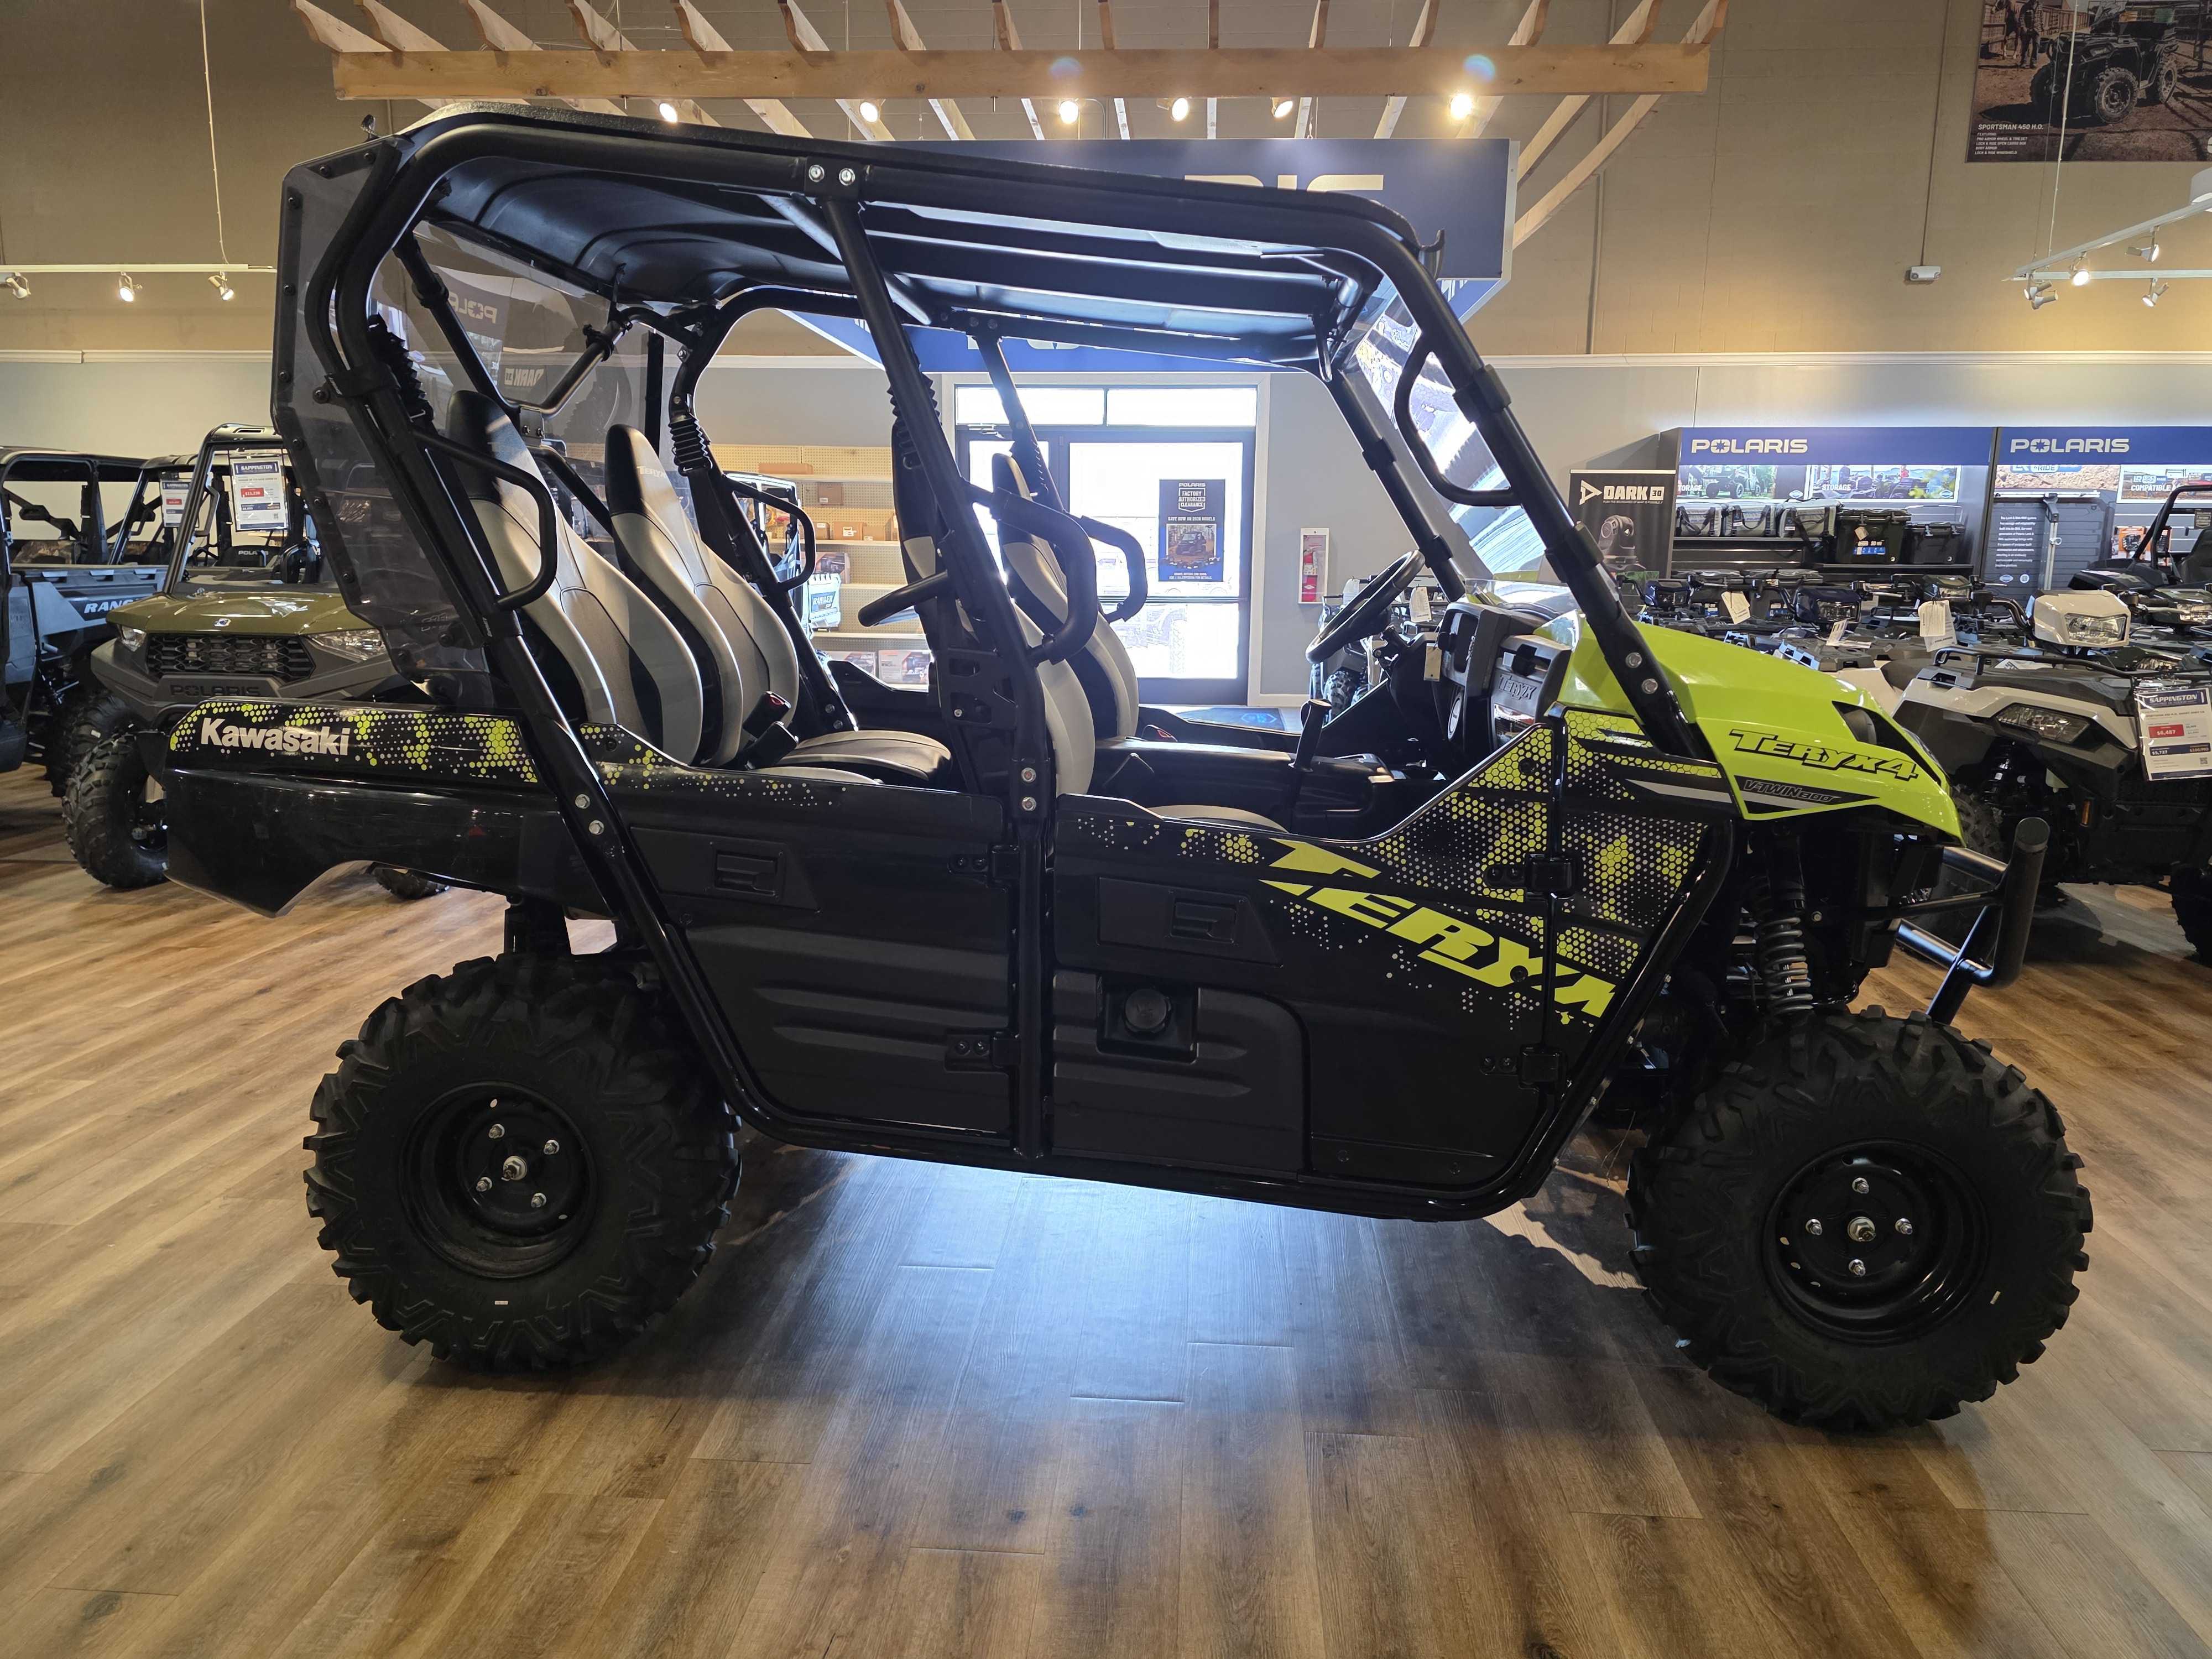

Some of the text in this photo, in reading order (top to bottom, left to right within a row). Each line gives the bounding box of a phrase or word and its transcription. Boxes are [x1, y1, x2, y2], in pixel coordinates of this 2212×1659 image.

[1691, 439, 1808, 453] POLARIS
[2010, 439, 2130, 453] POLARIS
[1604, 486, 1648, 500] DARK
[1822, 483, 1852, 492] STORAGE
[813, 596, 833, 605] RANGER
[170, 684, 260, 696] POLARIS
[1499, 674, 1537, 700] TERYX
[2150, 694, 2198, 703] SAPPINGTON
[201, 718, 350, 755] Kawasaki
[1729, 729, 1919, 781] TERYX4
